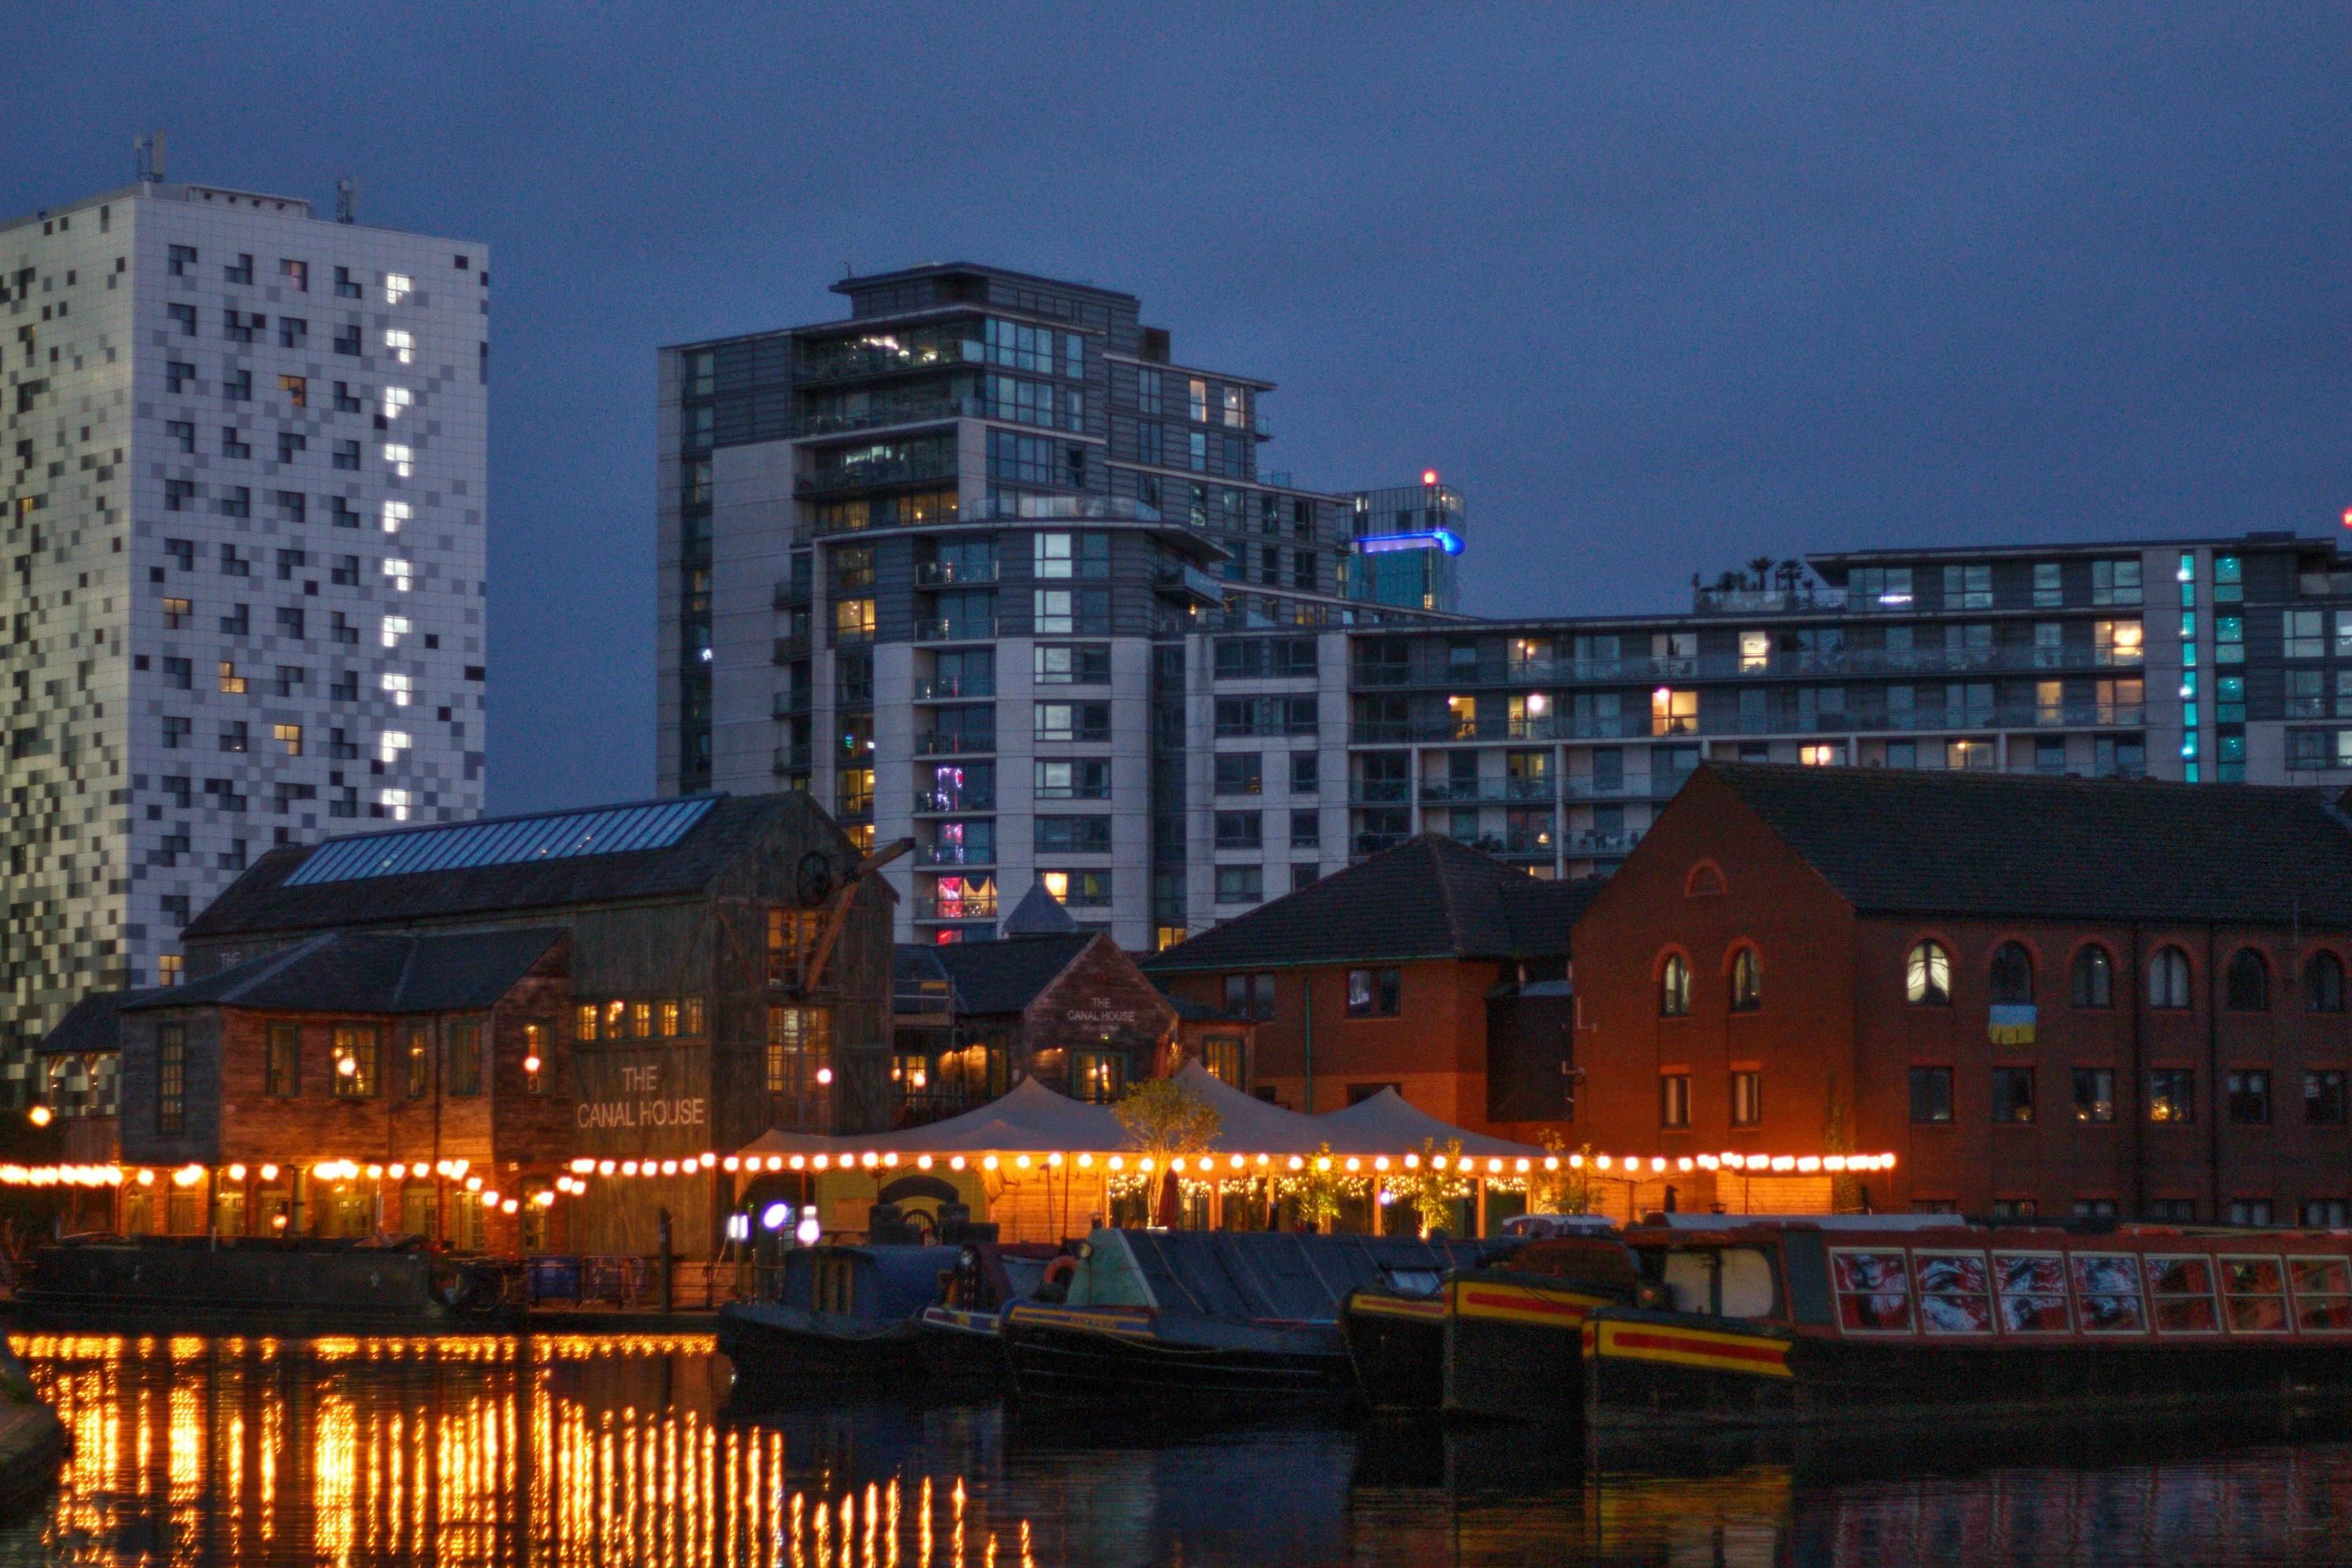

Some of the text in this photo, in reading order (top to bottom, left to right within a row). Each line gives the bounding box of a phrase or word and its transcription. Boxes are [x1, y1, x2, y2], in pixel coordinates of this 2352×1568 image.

[1091, 997, 1111, 1009] THE
[1067, 1010, 1135, 1022] CANAL HOUSE
[622, 1065, 659, 1092] THE
[577, 1098, 705, 1128] CANAL HOUSE
